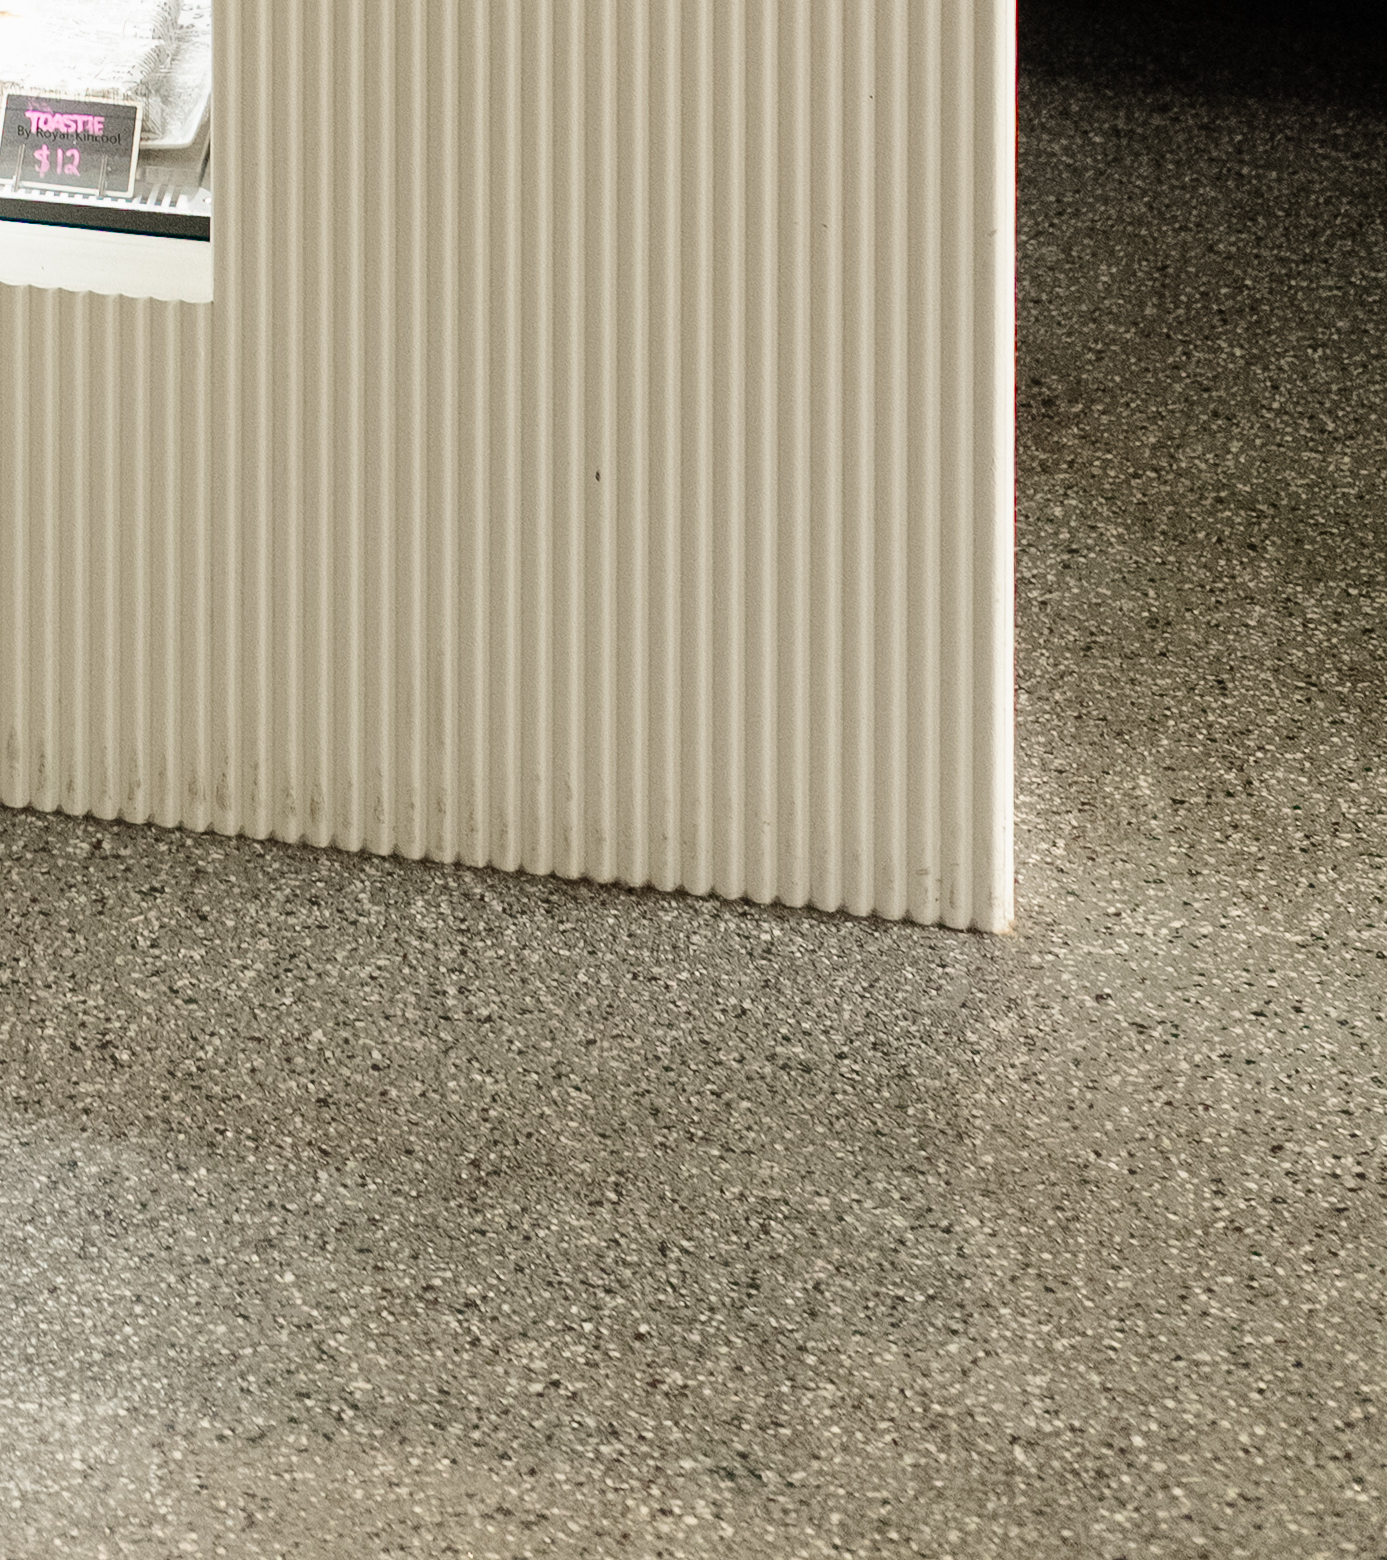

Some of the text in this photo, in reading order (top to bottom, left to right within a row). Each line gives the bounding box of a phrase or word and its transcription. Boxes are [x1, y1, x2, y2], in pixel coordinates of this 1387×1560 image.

[17, 125, 31, 139] By
[25, 110, 105, 136] TOASTIE
[33, 144, 80, 178] $12
